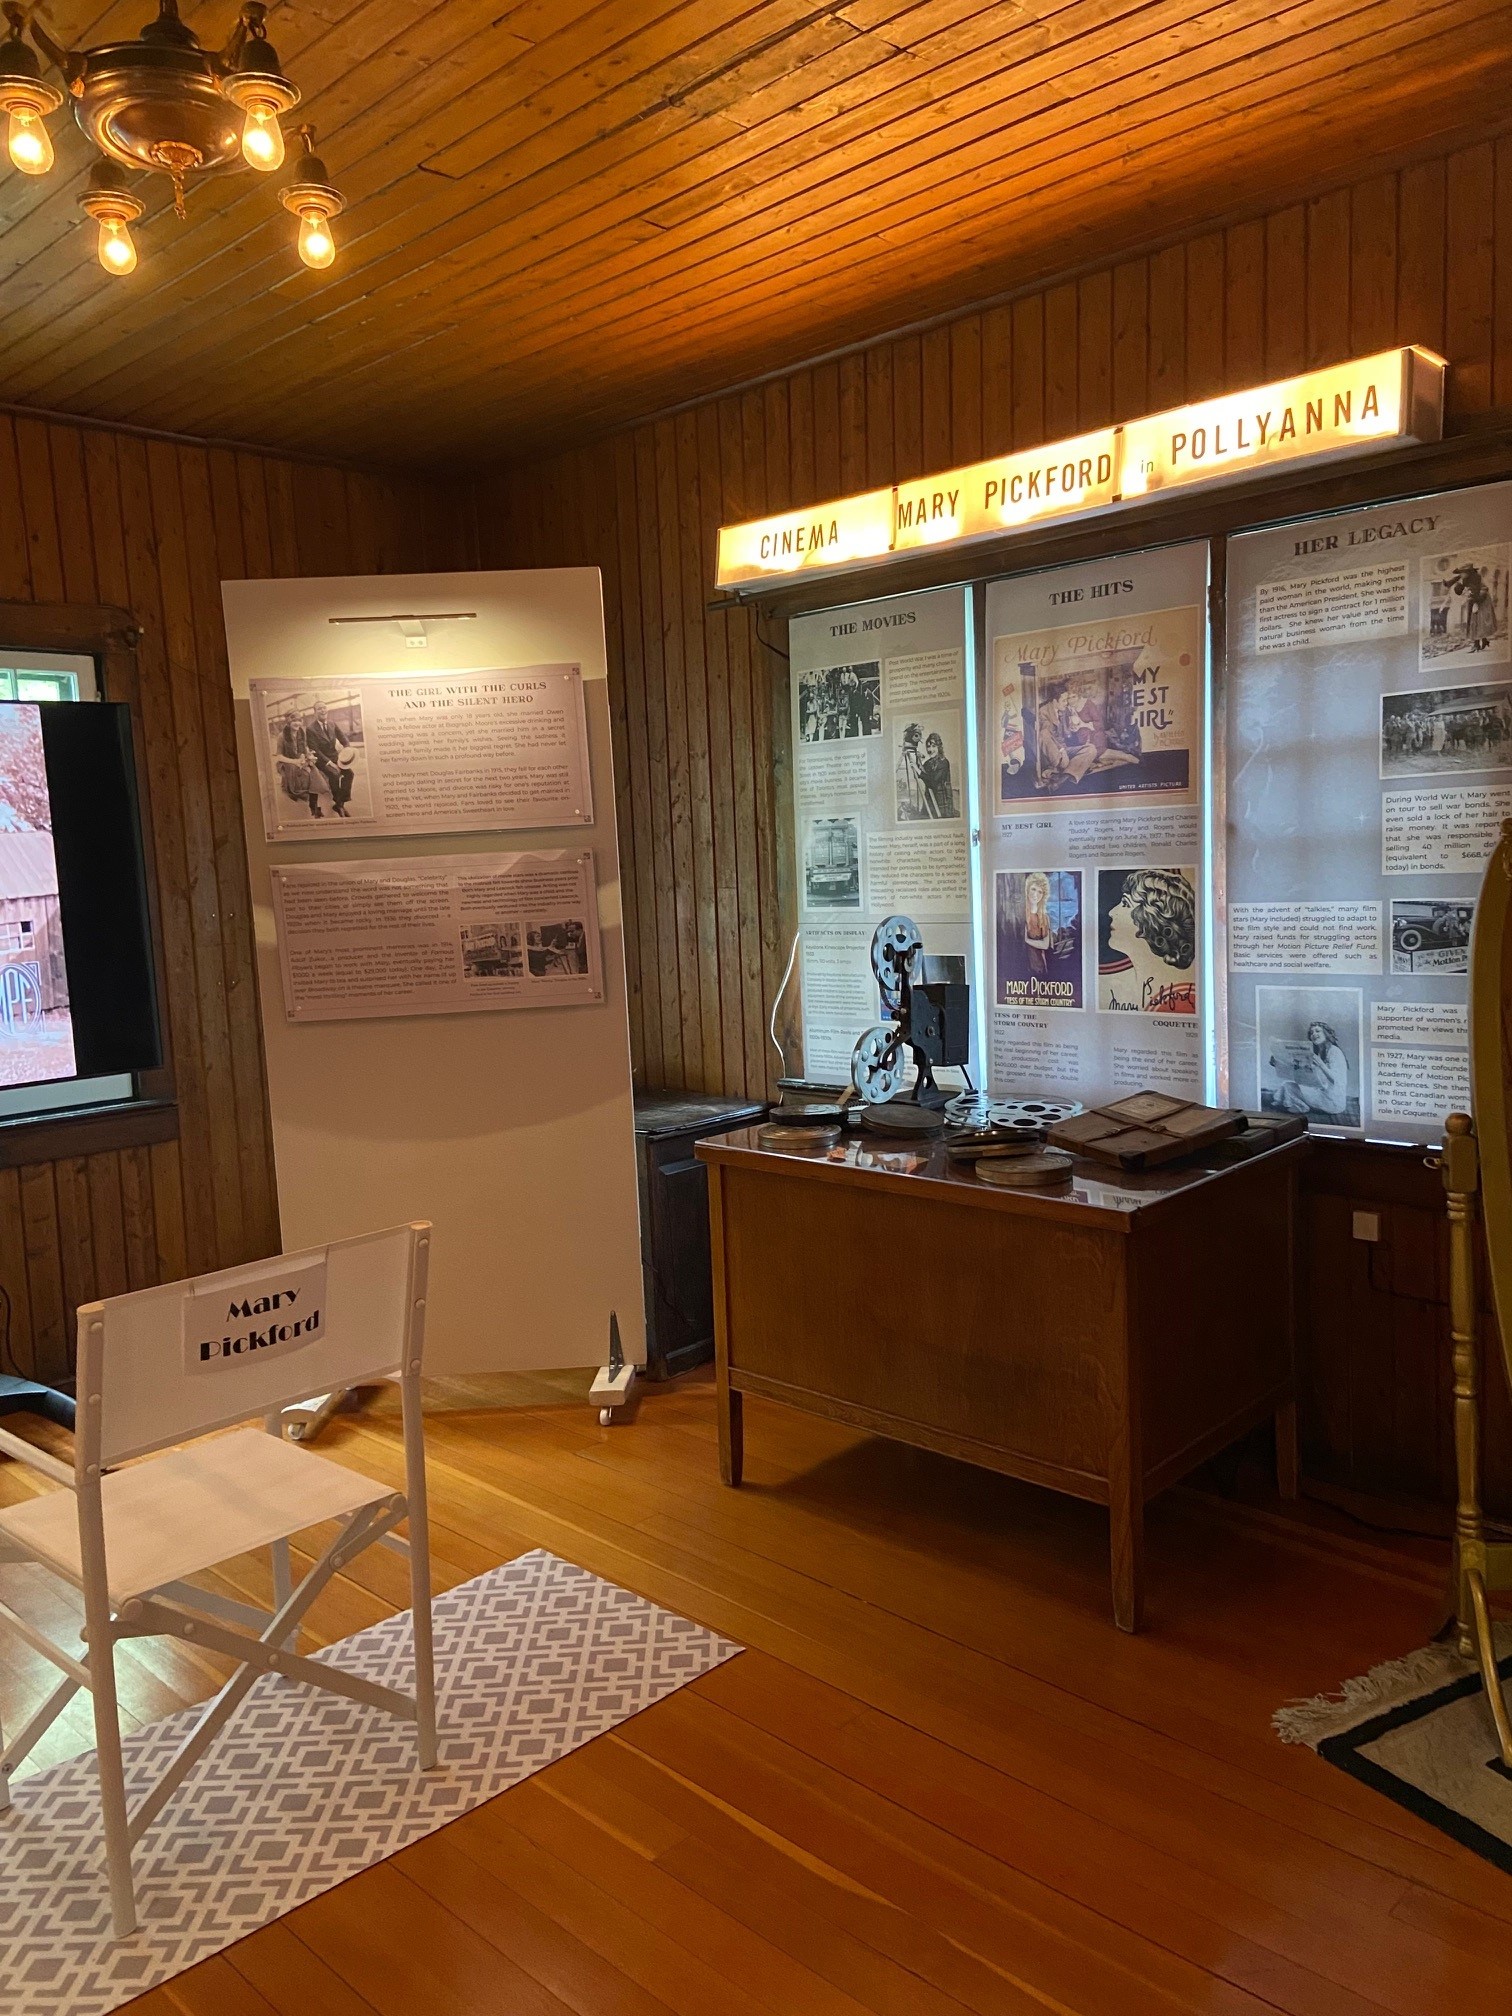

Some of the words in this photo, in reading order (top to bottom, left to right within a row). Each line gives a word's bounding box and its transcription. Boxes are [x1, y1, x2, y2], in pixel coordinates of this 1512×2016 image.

[760, 521, 839, 560] CINEMA
[898, 489, 959, 530] MARY
[984, 454, 1111, 509] PICKFORD
[1141, 458, 1154, 474] in
[1171, 385, 1380, 466] POLLYANNA
[1294, 536, 1338, 555] HER
[1348, 516, 1440, 546] LEGACY
[1049, 589, 1084, 605] THE
[1090, 580, 1133, 599] HITS
[1260, 587, 1269, 595] By
[1310, 575, 1340, 586] Pickford
[1378, 564, 1405, 576] highest
[1260, 594, 1275, 605] paid
[1277, 592, 1303, 600] woman
[1330, 583, 1350, 592] world,
[1354, 579, 1382, 588] making
[1260, 614, 1272, 622] first
[1308, 607, 1323, 615] sign
[1331, 600, 1360, 611] contract
[1380, 595, 1405, 604] million
[1290, 598, 1322, 608] American
[830, 623, 857, 636] THE
[862, 612, 916, 631] MOVIES
[1004, 644, 1058, 666] Mary
[1068, 626, 1157, 653] Pickford
[1133, 666, 1160, 685] MY
[388, 689, 411, 697] THE
[446, 686, 477, 694] WITH
[510, 682, 546, 691] CURLS
[404, 701, 425, 709] AND
[458, 697, 498, 706] SILENT
[1007, 981, 1027, 995] MARY
[1031, 977, 1073, 998] PICKFORD
[226, 1288, 300, 1322] Mary
[201, 1310, 319, 1361] Pickford
